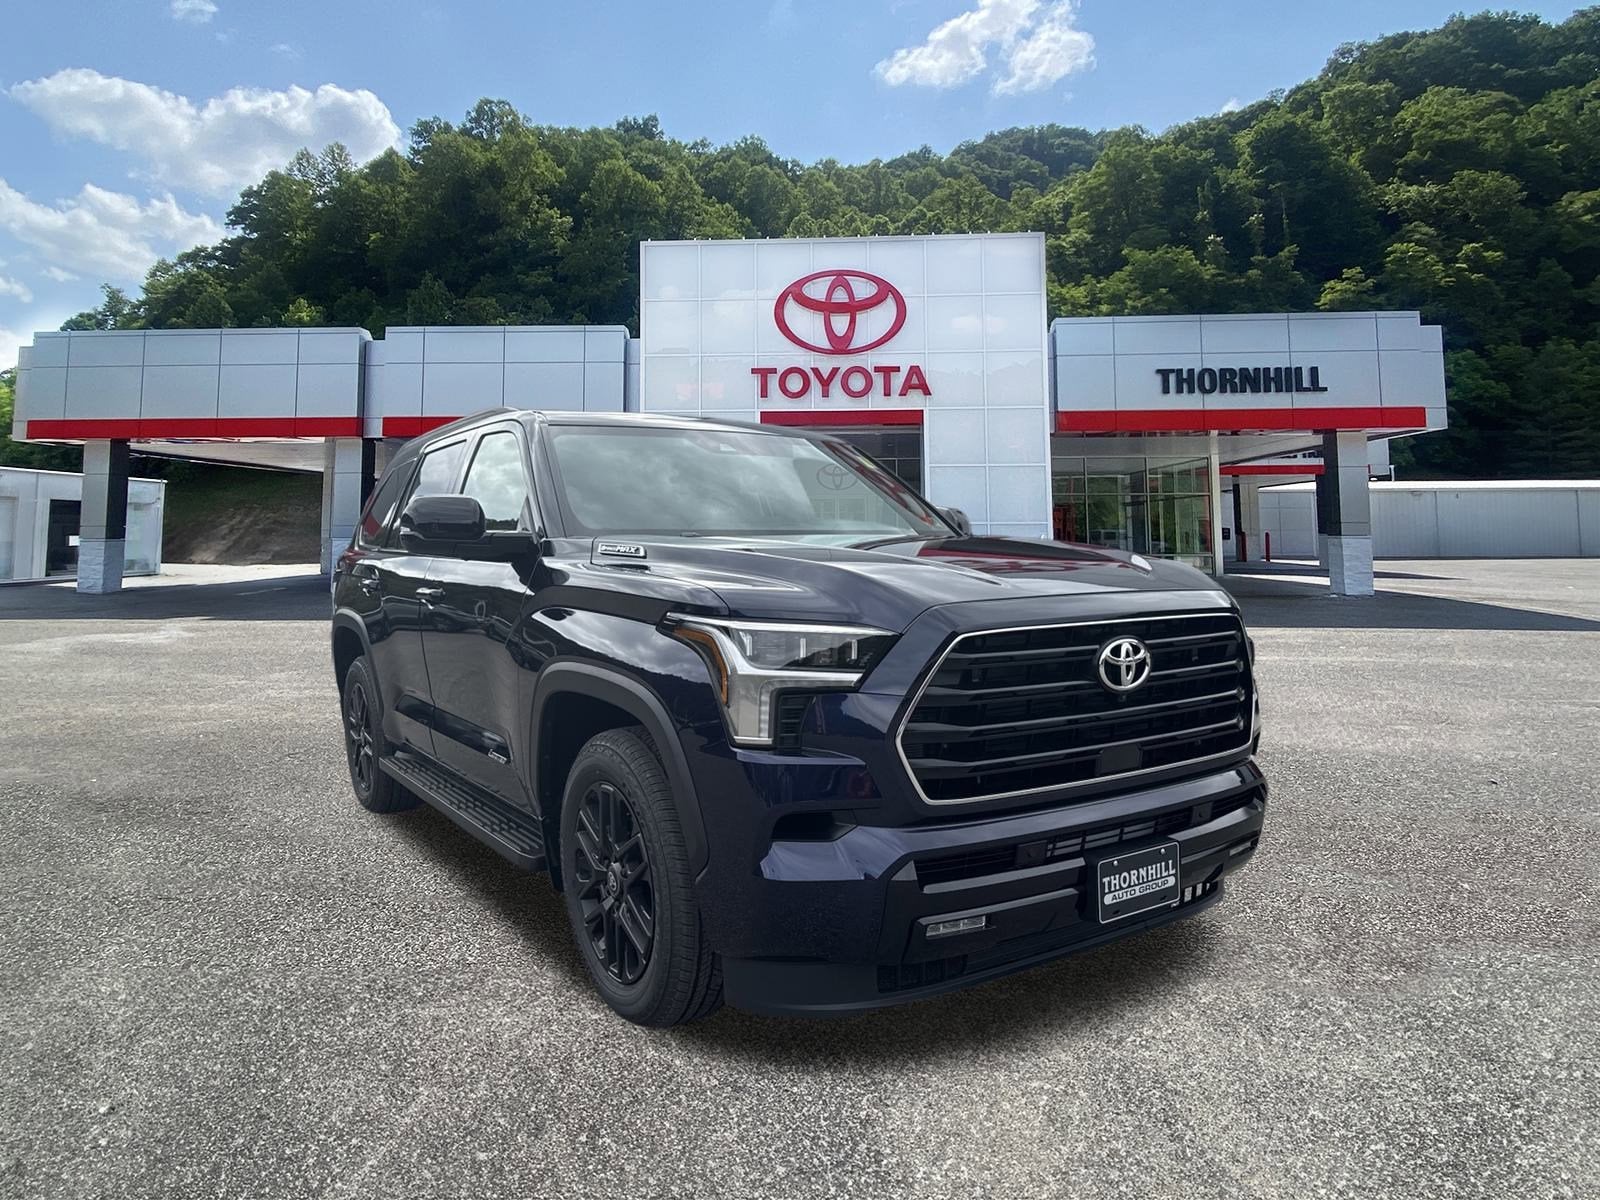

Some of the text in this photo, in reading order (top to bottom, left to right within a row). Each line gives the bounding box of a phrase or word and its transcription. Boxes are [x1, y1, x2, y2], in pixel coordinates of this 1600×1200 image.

[751, 365, 932, 399] TOYOTA
[1156, 366, 1328, 394] THORNHILL
[1103, 860, 1176, 893] THORNHILL
[1111, 879, 1169, 902] AUTO GROUP
